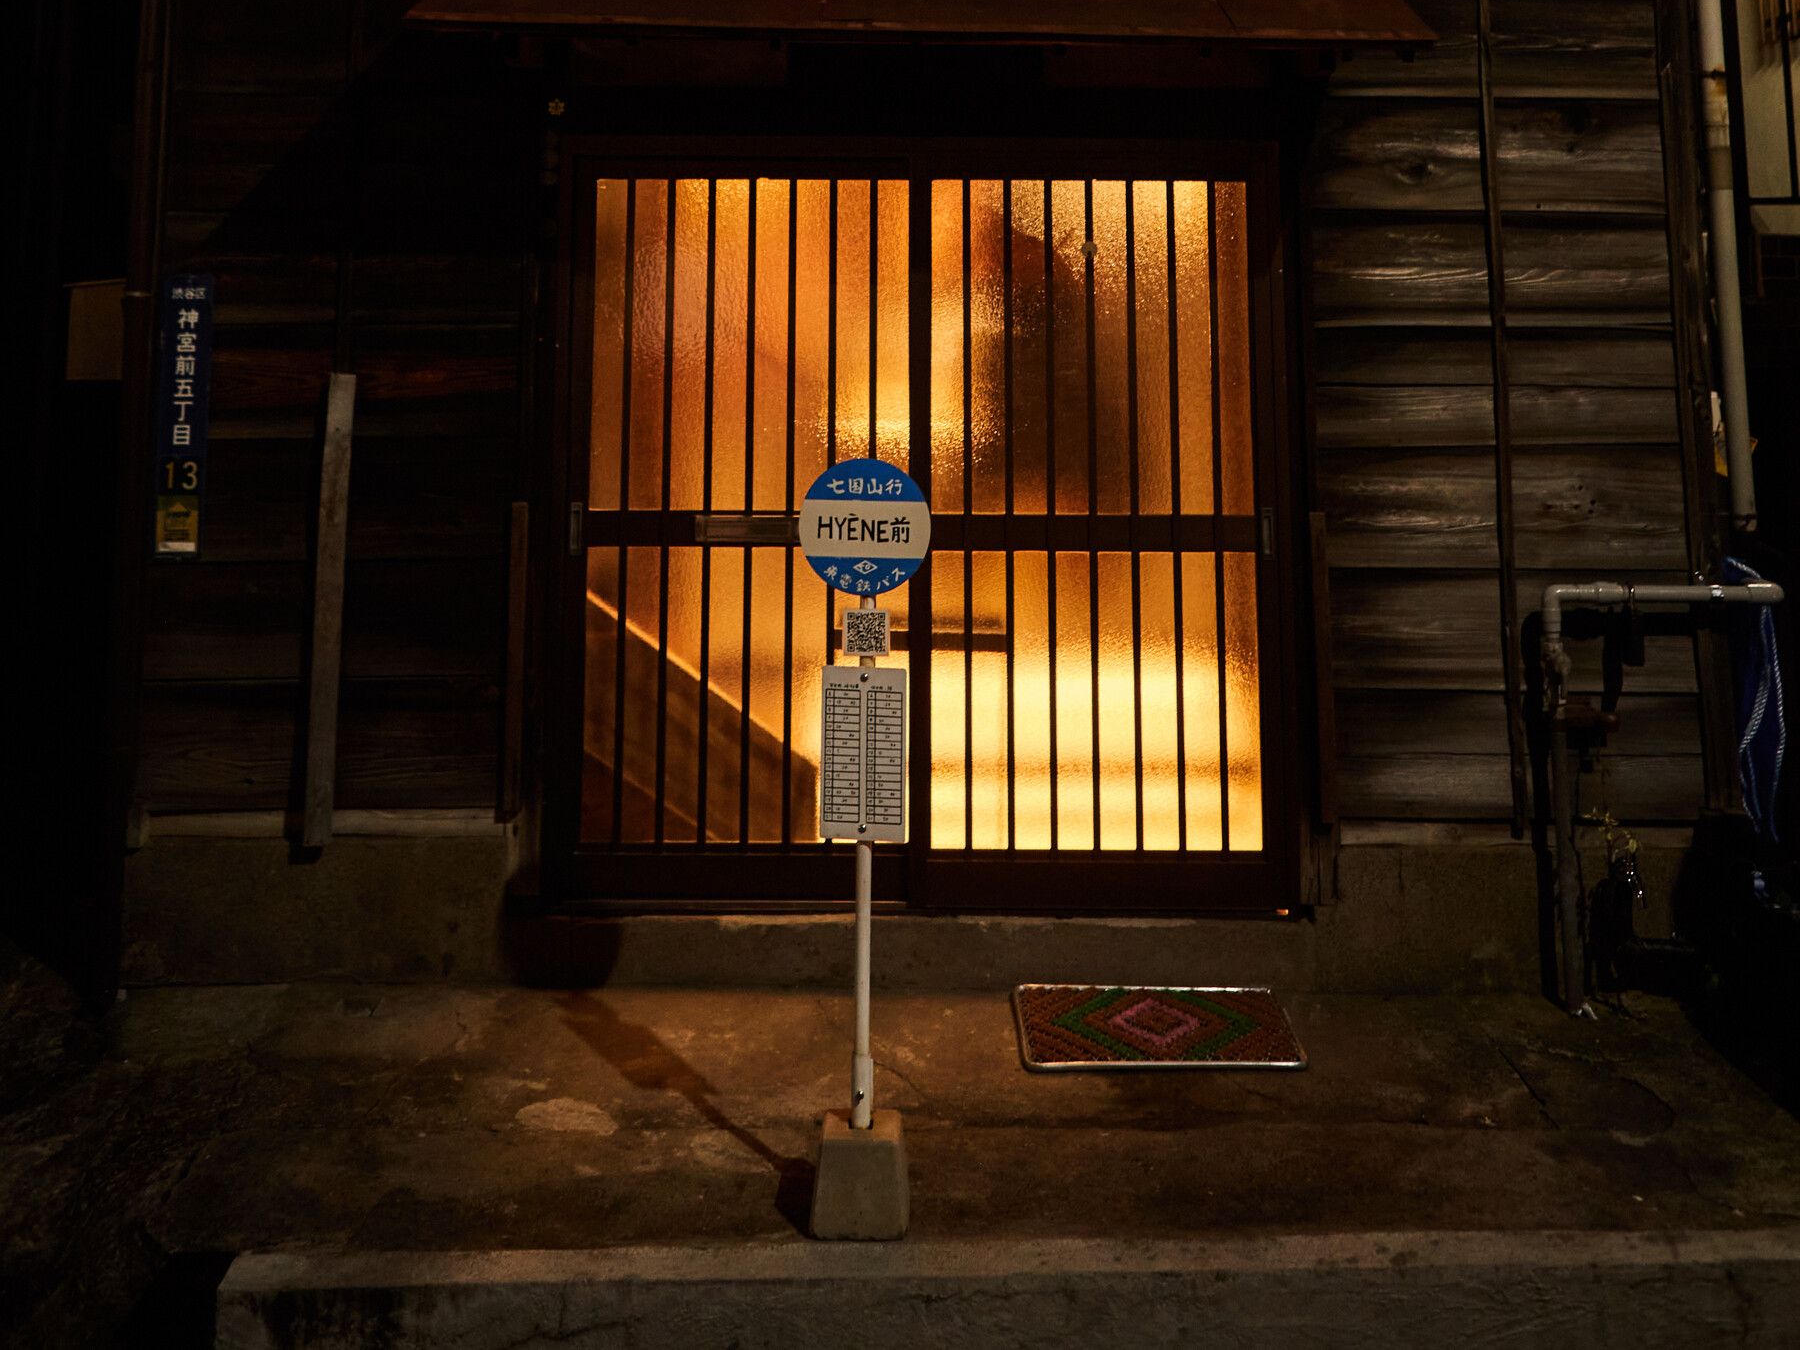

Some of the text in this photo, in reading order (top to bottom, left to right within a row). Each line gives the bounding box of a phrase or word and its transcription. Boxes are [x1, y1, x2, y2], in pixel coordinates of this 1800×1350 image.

[171, 287, 207, 300] 渋谷区
[172, 308, 200, 446] 神宮前五丁目
[165, 460, 198, 491] 13
[826, 477, 903, 495] 七国山行
